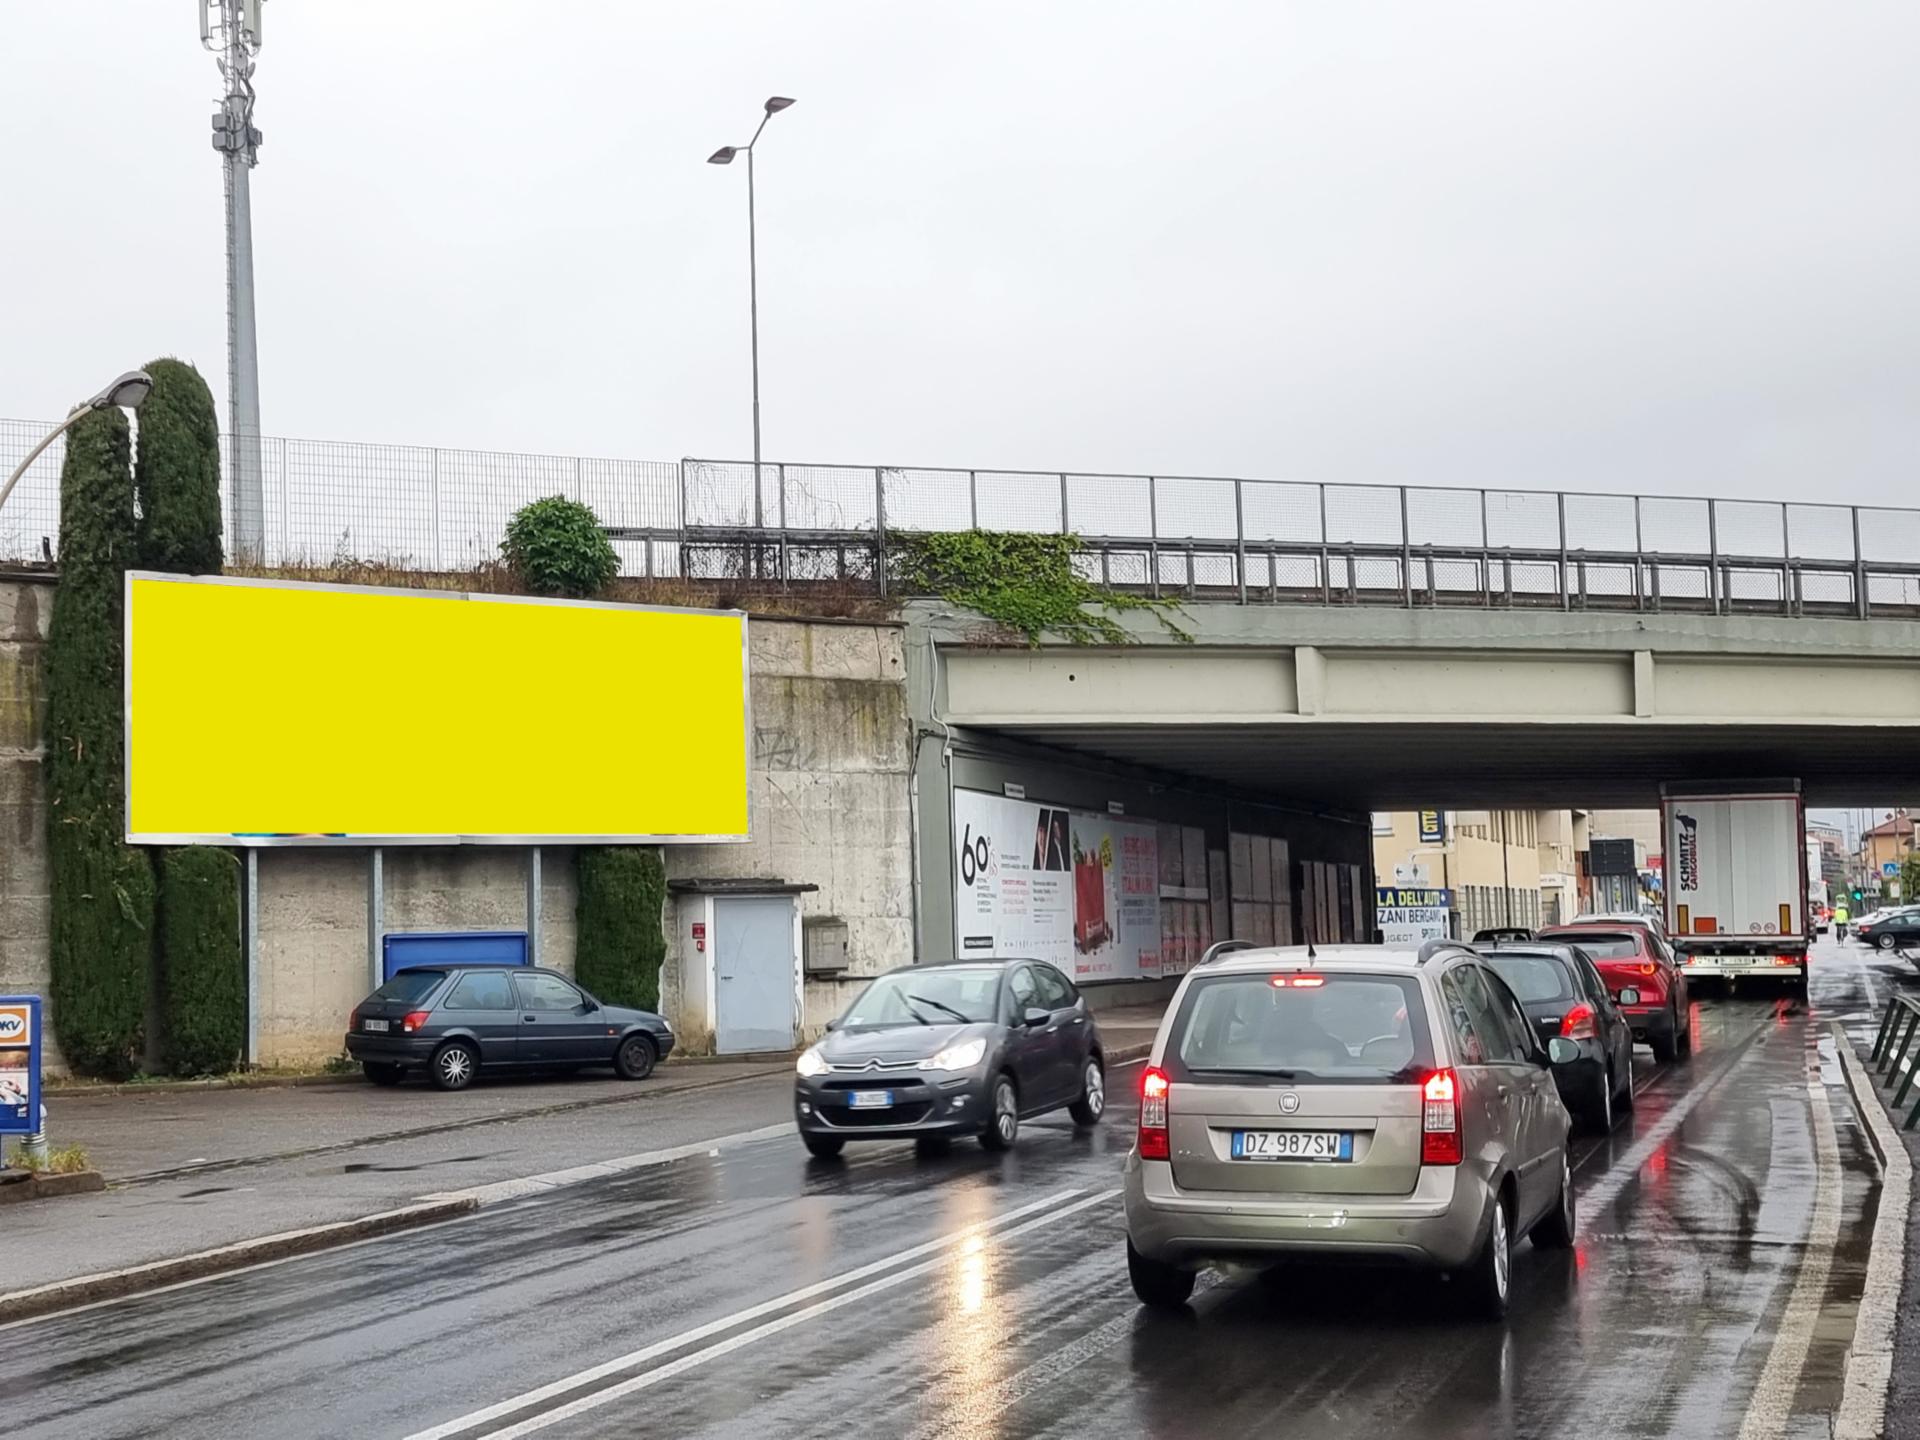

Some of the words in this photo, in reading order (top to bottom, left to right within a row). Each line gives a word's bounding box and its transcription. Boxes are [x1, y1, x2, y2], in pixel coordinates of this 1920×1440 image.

[1679, 833, 1690, 891] SCHMITZ
[1689, 832, 1698, 891] CARGOBULL
[1378, 909, 1406, 924] ZANI
[1245, 1133, 1268, 1154] DZ
[1277, 1134, 1338, 1155] 987SW
